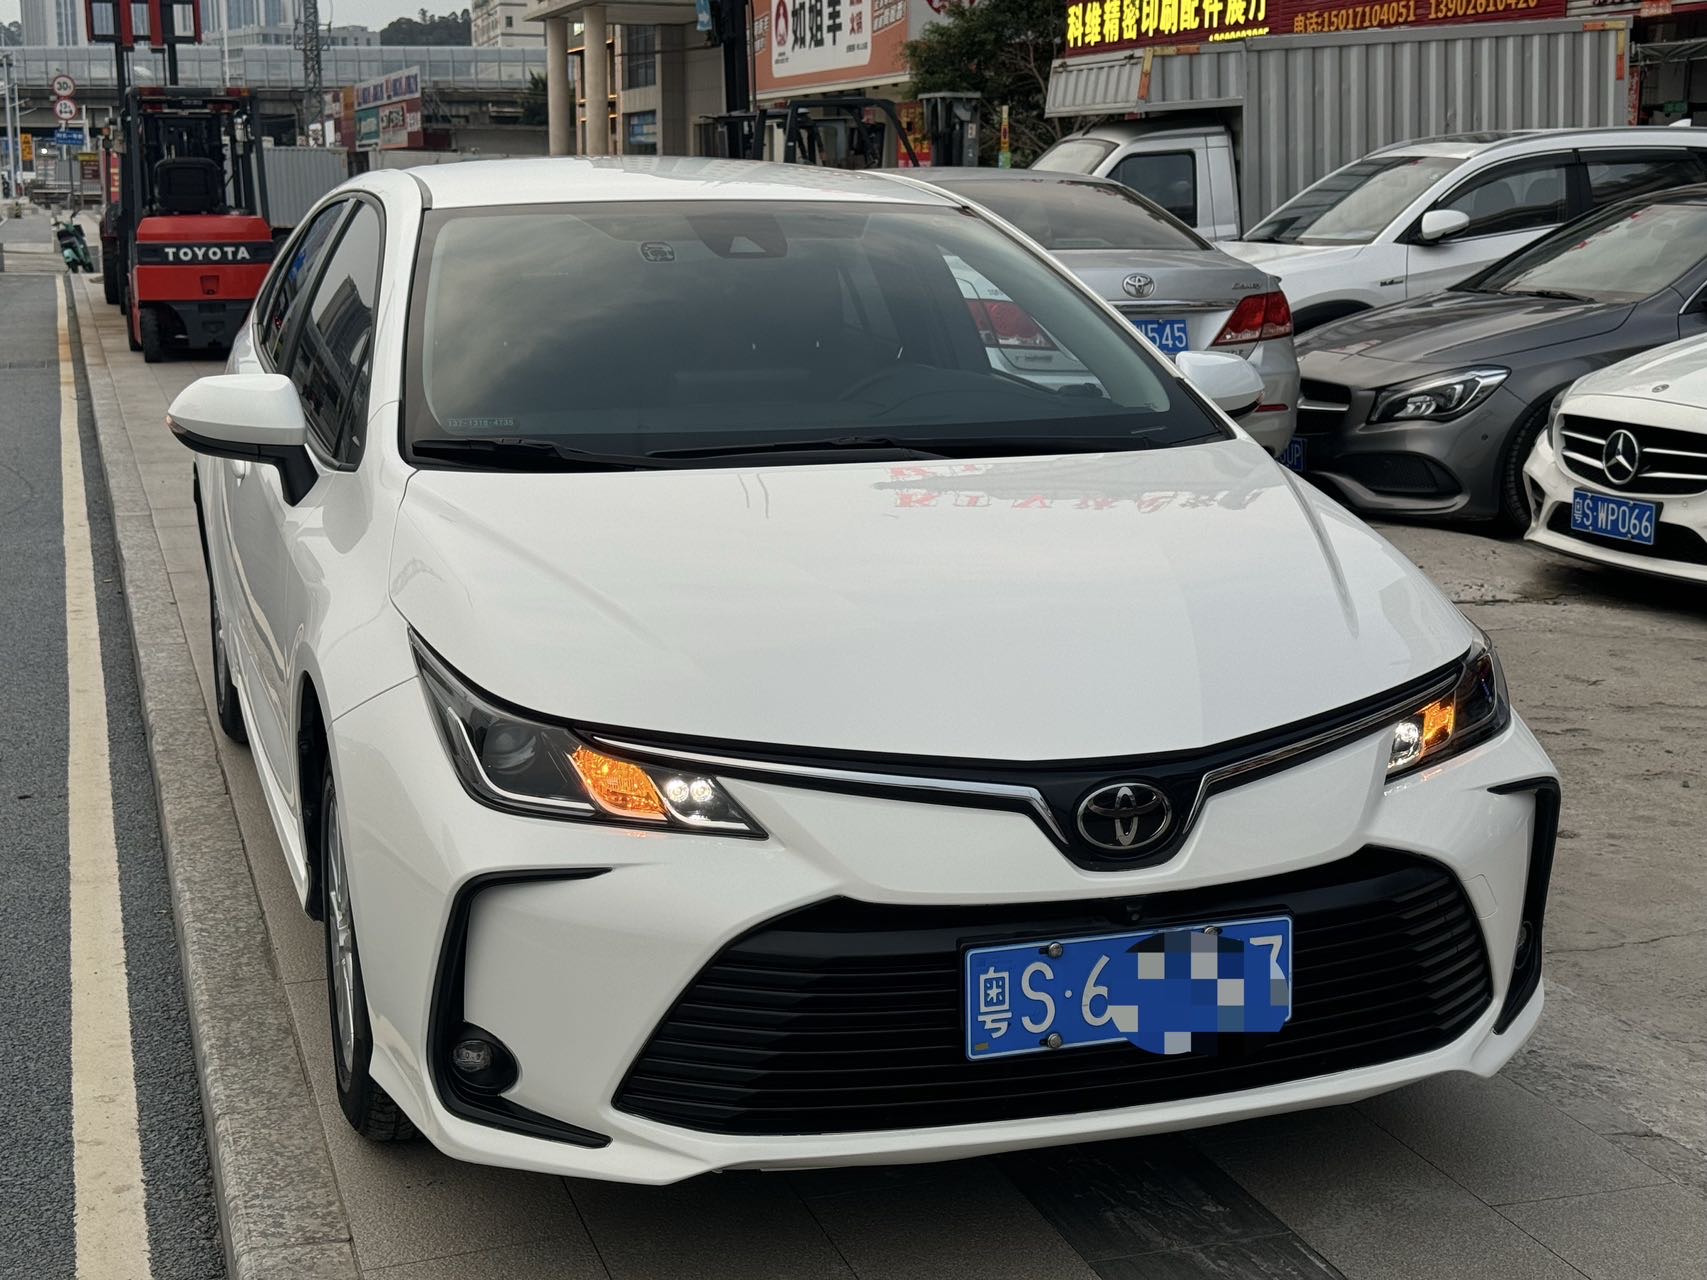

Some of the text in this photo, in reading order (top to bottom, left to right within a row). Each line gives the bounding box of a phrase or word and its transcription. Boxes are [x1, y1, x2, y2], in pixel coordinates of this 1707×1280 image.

[164, 246, 250, 261] TOYOTA
[1138, 323, 1187, 348] 545
[977, 934, 1286, 1038] 粤S·67
